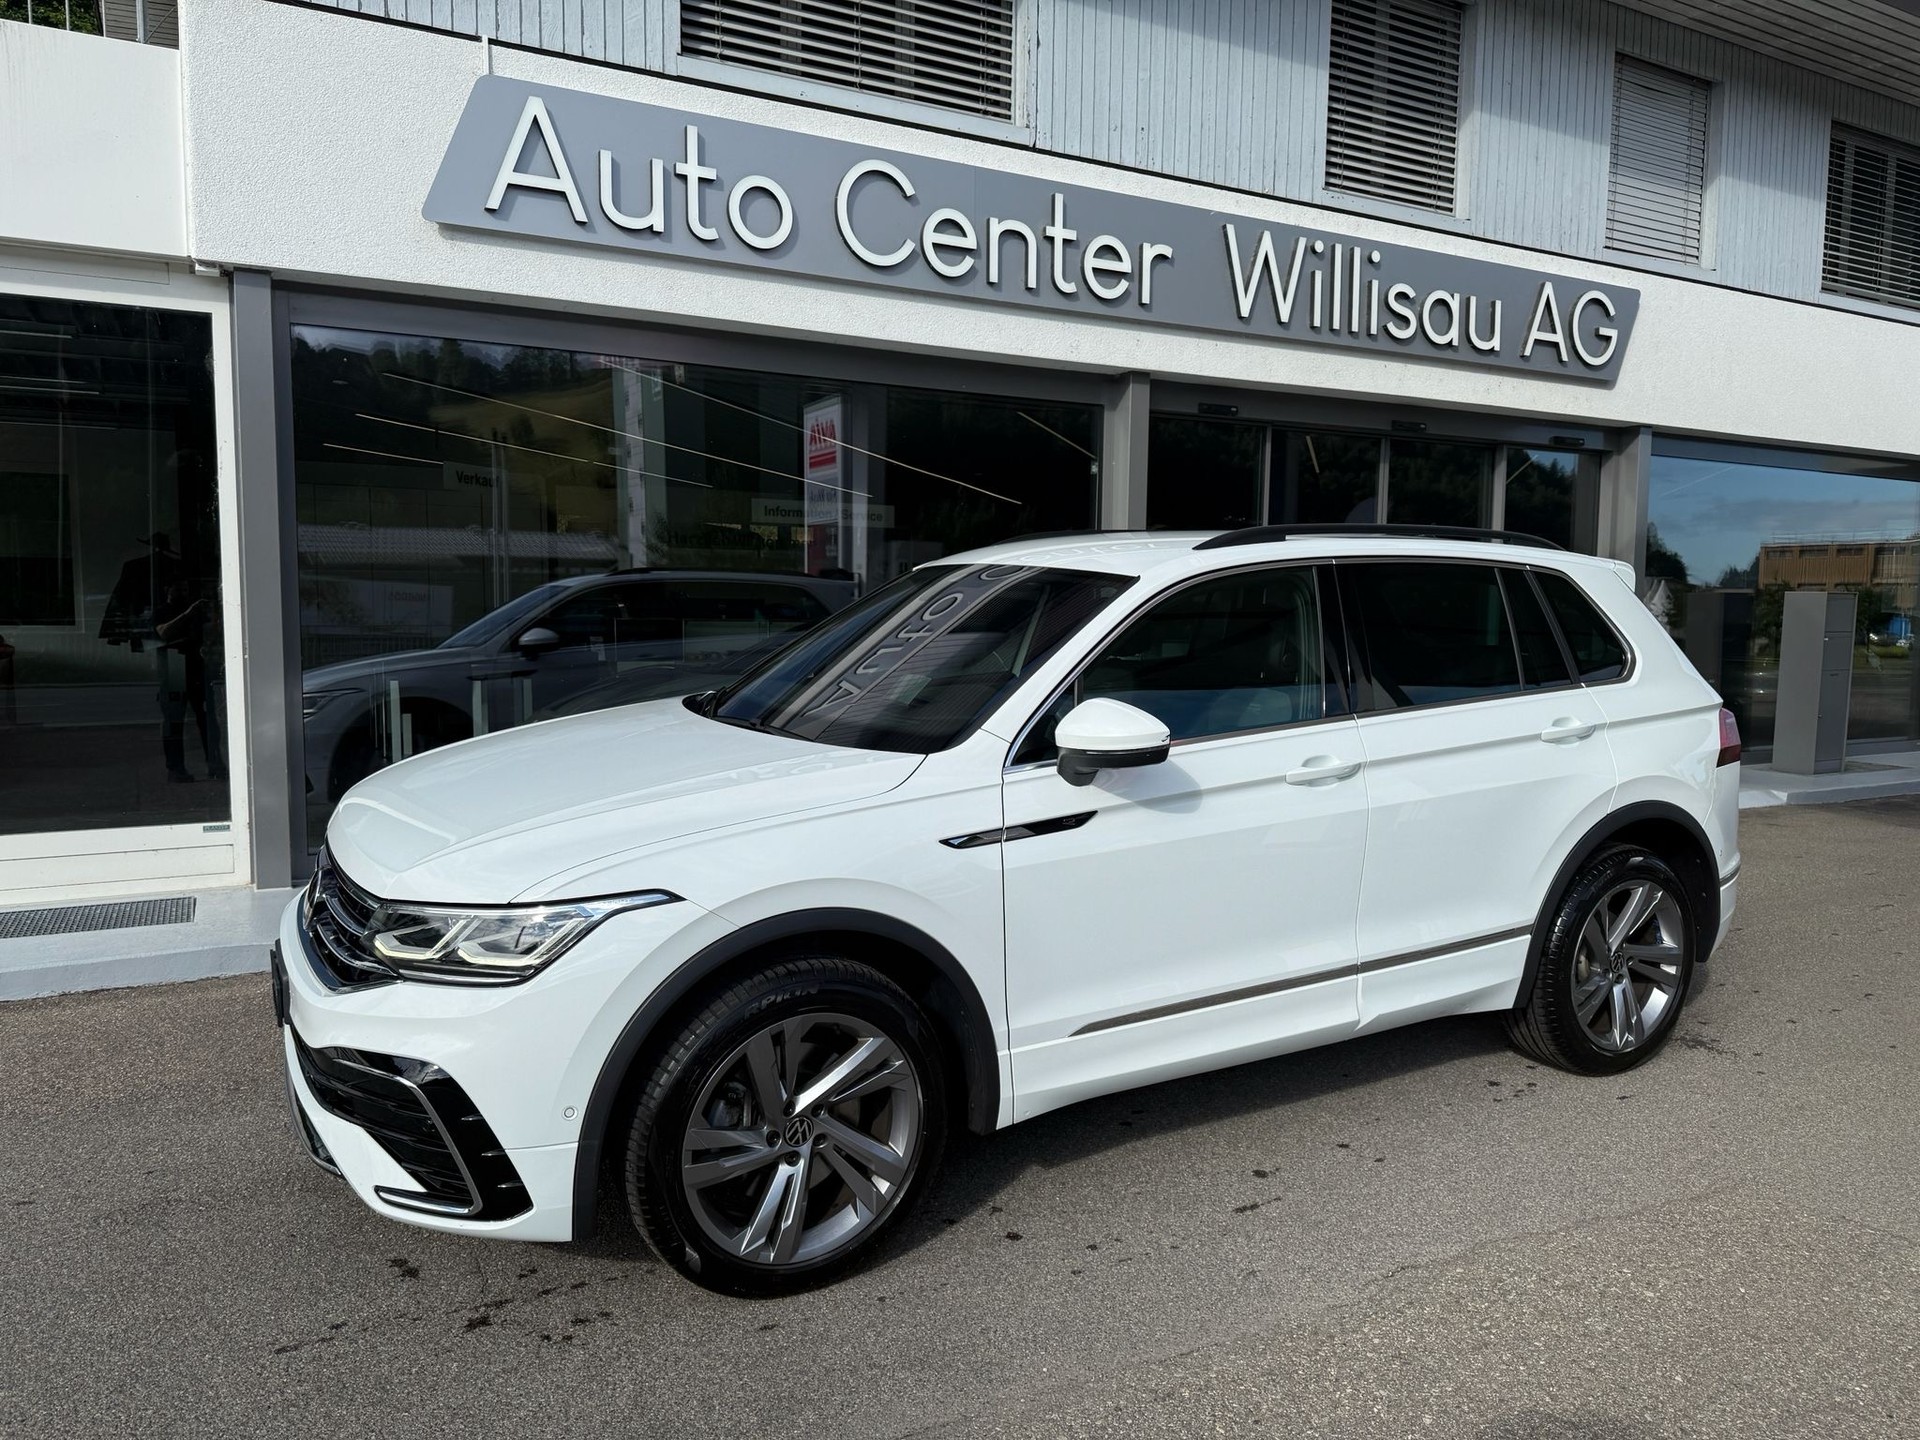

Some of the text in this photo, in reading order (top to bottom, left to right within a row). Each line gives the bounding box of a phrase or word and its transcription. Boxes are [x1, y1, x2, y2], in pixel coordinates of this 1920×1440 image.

[484, 96, 1619, 367] Auto Center Willisau AG
[764, 505, 832, 520] Informtion
